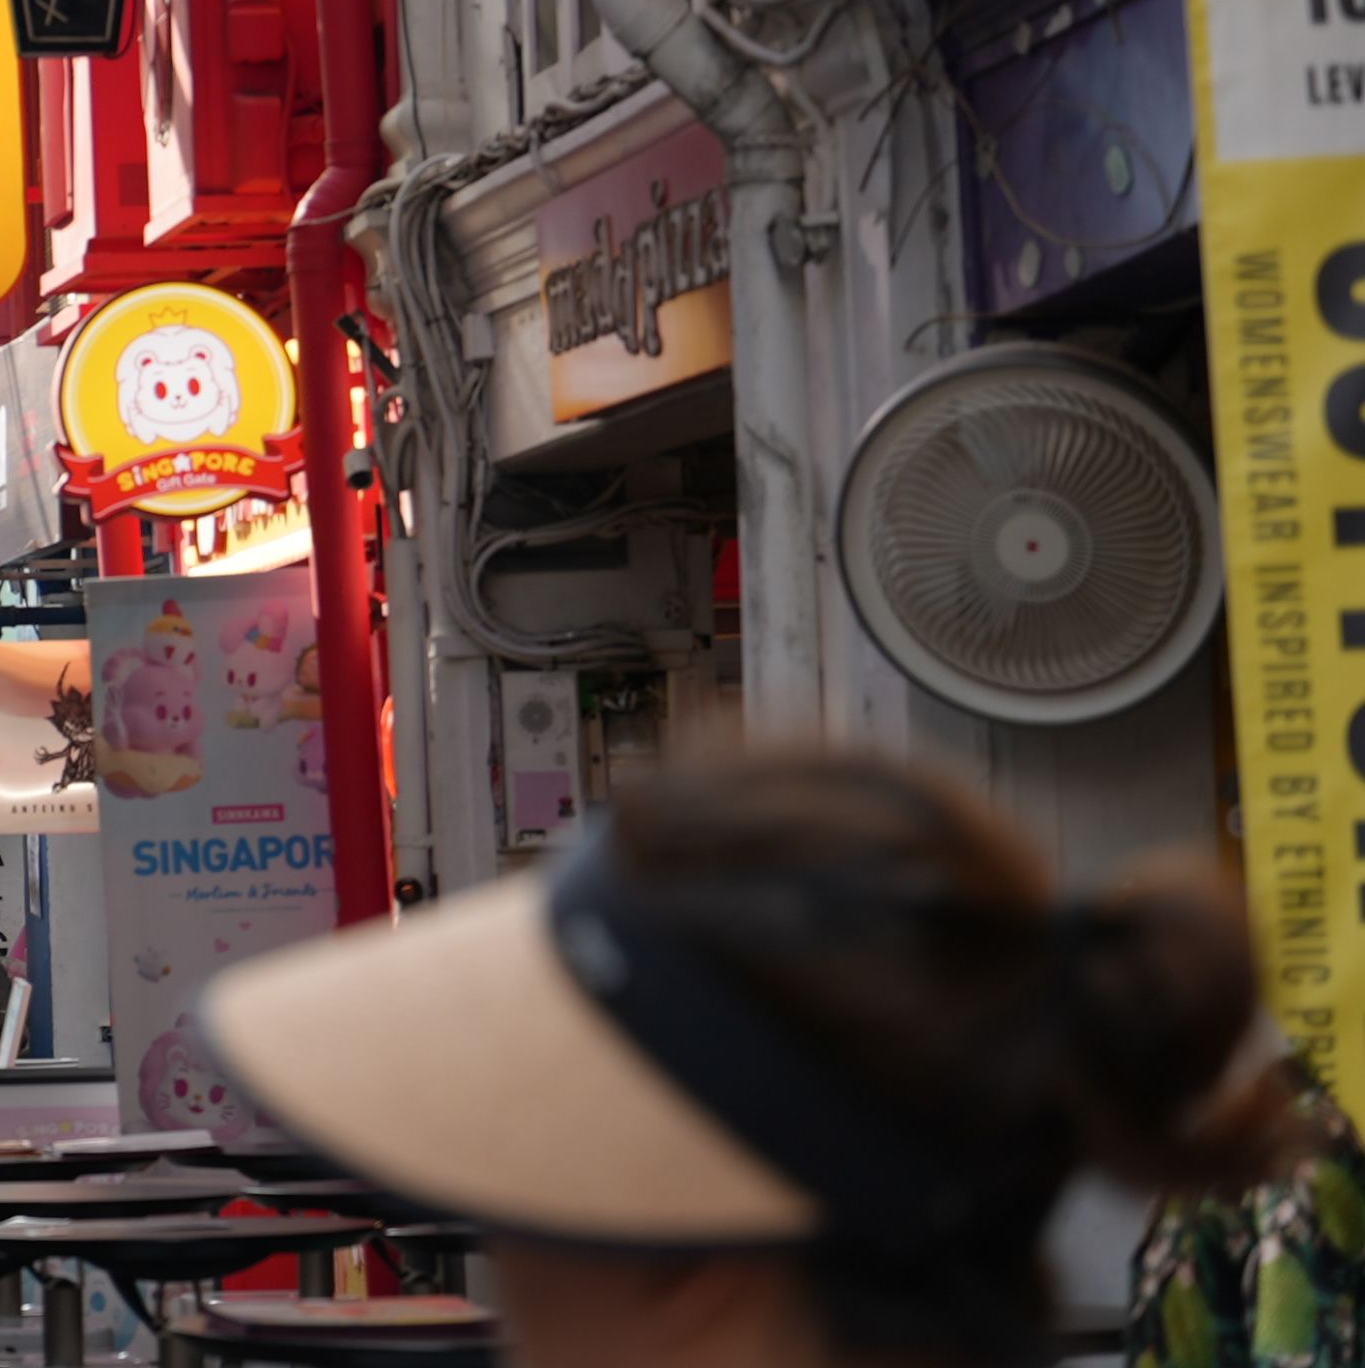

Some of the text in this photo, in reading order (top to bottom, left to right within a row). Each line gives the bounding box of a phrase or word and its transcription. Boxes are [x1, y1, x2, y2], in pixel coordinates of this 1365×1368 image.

[1233, 246, 1302, 545] WOMENSWEAR
[156, 472, 217, 492] Gift Gate
[1256, 564, 1317, 753] INSPIRED
[1269, 772, 1321, 824] BY
[1274, 844, 1332, 986] ETHNIC
